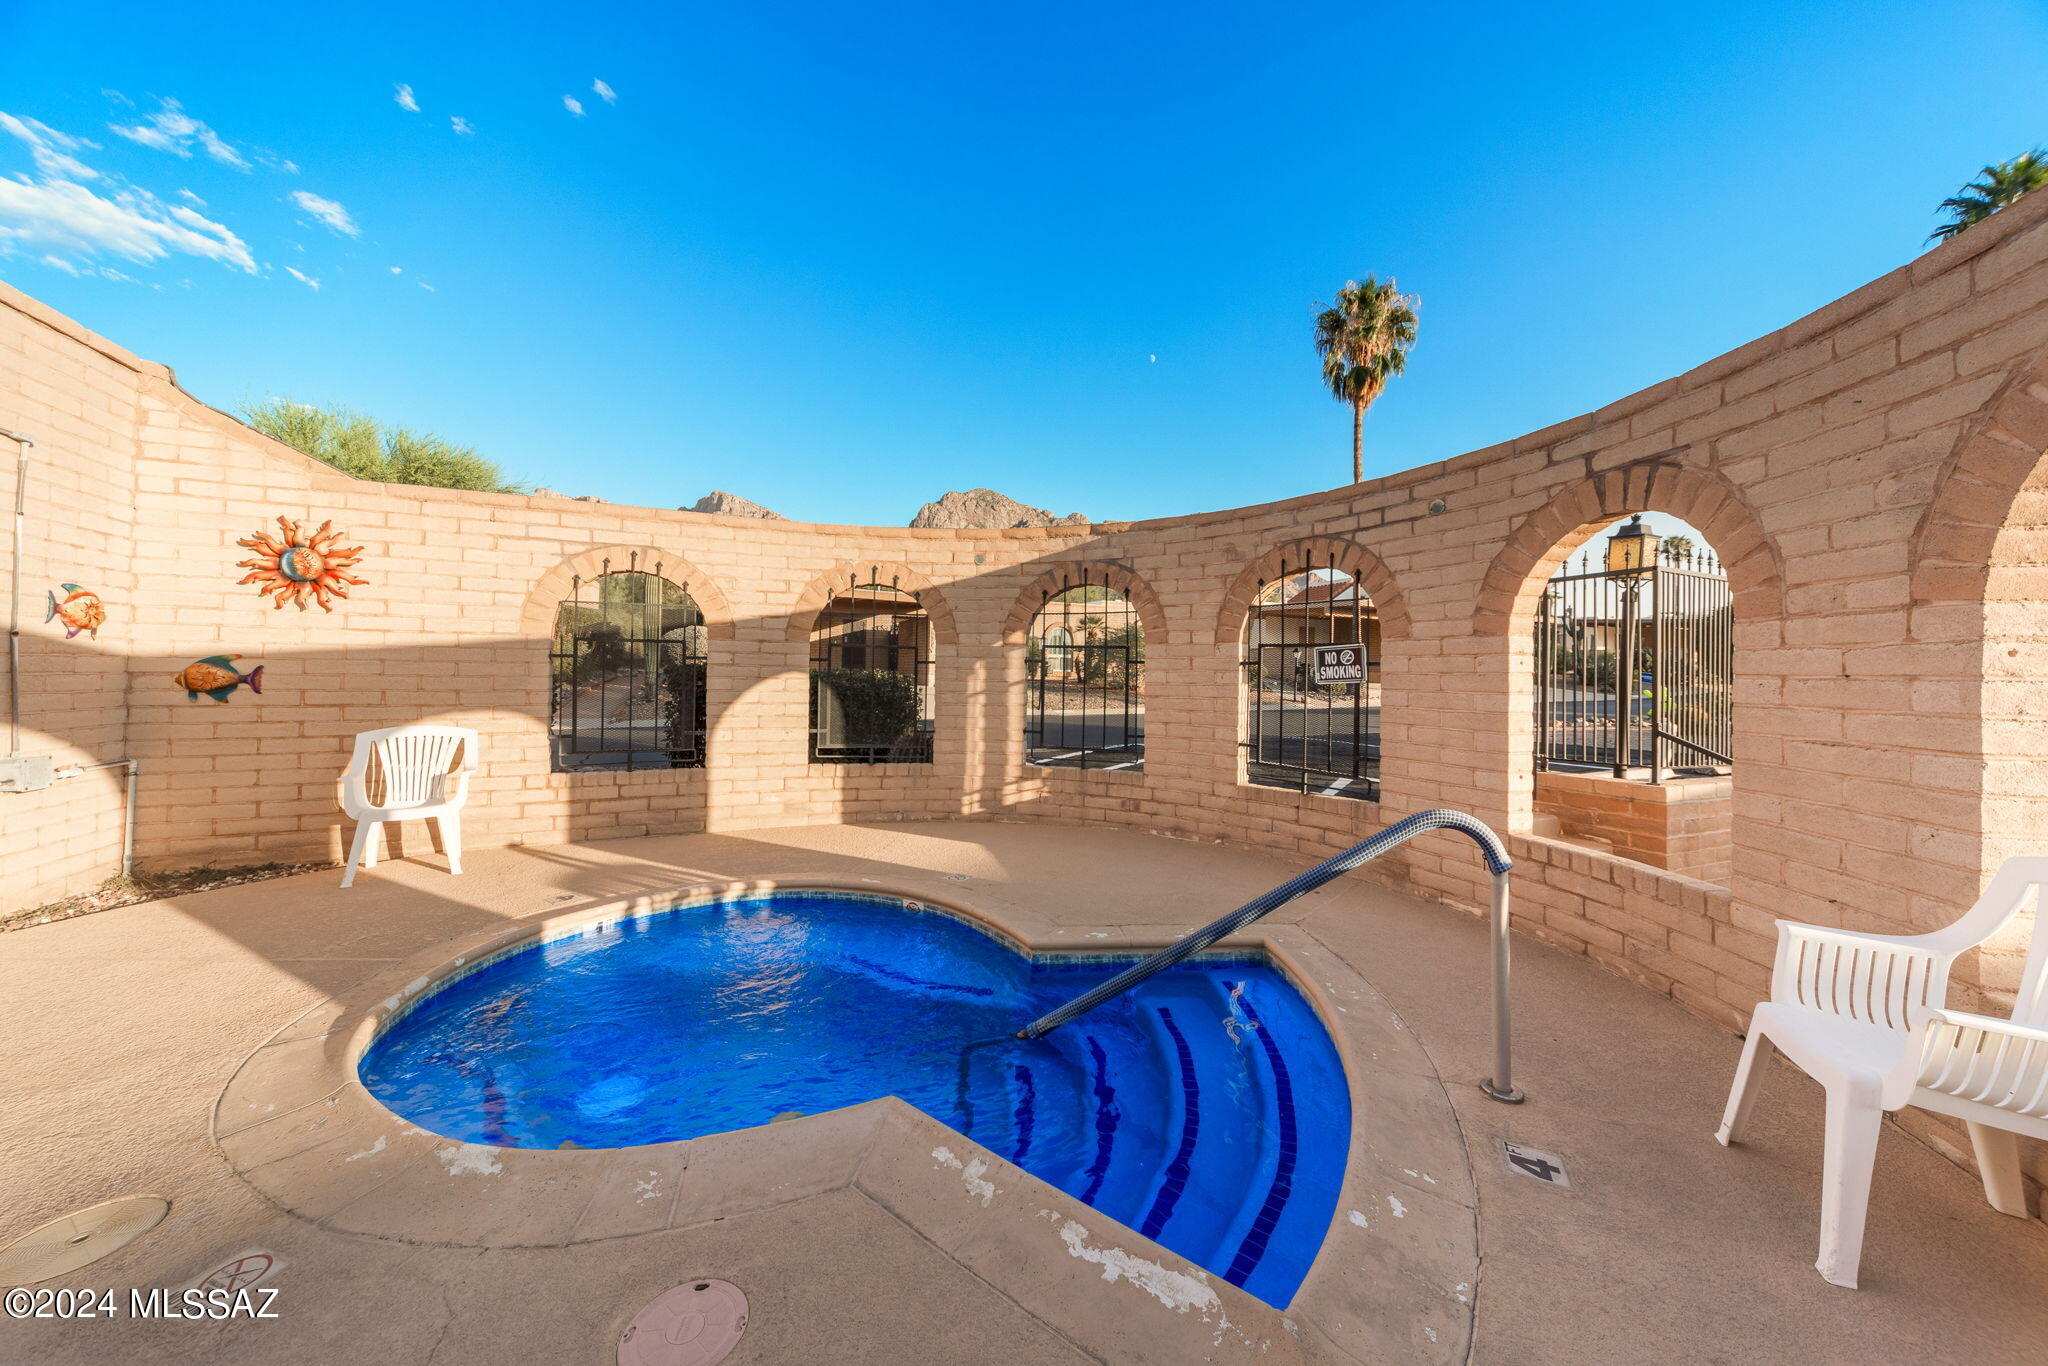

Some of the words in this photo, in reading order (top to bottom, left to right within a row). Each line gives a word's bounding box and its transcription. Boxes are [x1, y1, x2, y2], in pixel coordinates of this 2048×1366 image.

[1324, 651, 1337, 665] NO
[1320, 665, 1361, 679] SMOKING
[1503, 1141, 1522, 1156] FT
[1508, 1153, 1561, 1182] 4
